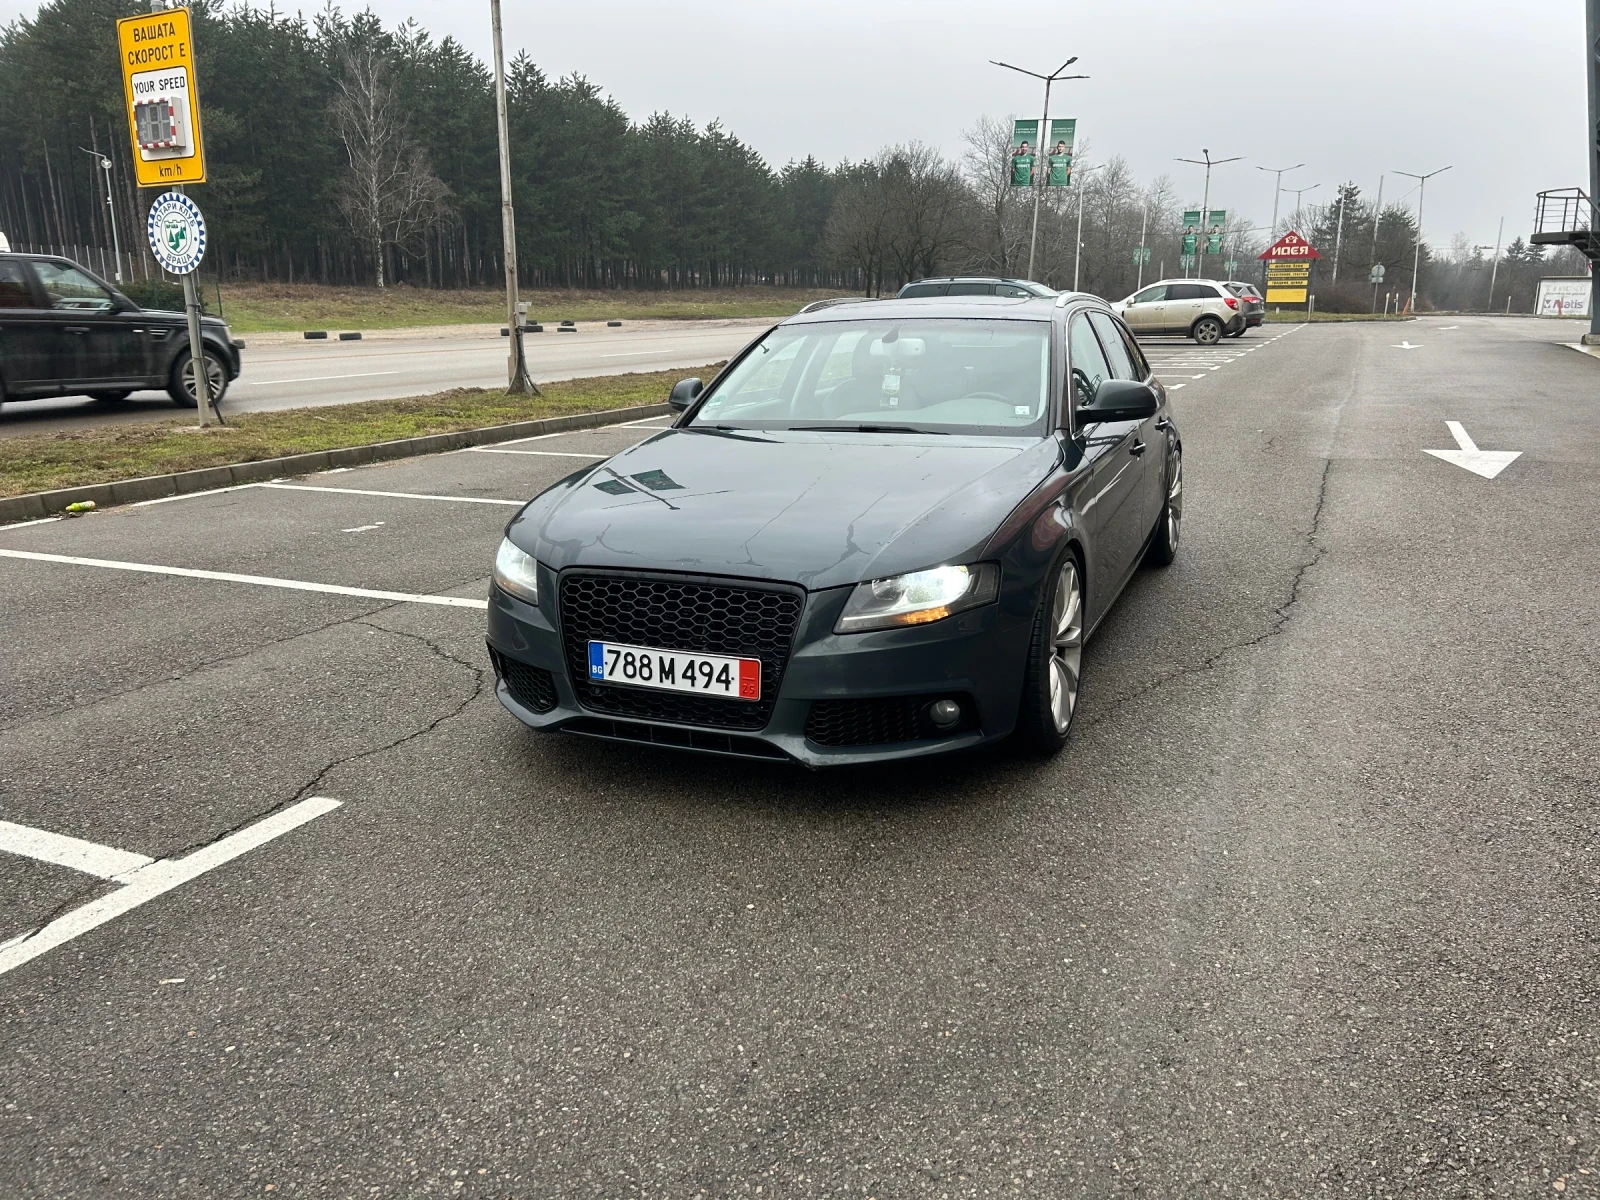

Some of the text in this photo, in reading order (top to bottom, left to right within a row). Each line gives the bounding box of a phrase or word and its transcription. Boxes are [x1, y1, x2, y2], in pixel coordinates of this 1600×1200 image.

[133, 22, 176, 42] ВАШАТА
[128, 43, 186, 65] СКОРОСТ Е
[134, 76, 185, 94] YOUR SPEED
[159, 164, 182, 177] km/h
[155, 203, 196, 228] РОТАРИ КЛУБ
[1272, 246, 1309, 255] ИДЕЯ
[166, 253, 192, 265] ВРАЦА
[592, 665, 603, 674] BG
[607, 649, 731, 691] 788 M 494
[742, 683, 755, 695] 25
